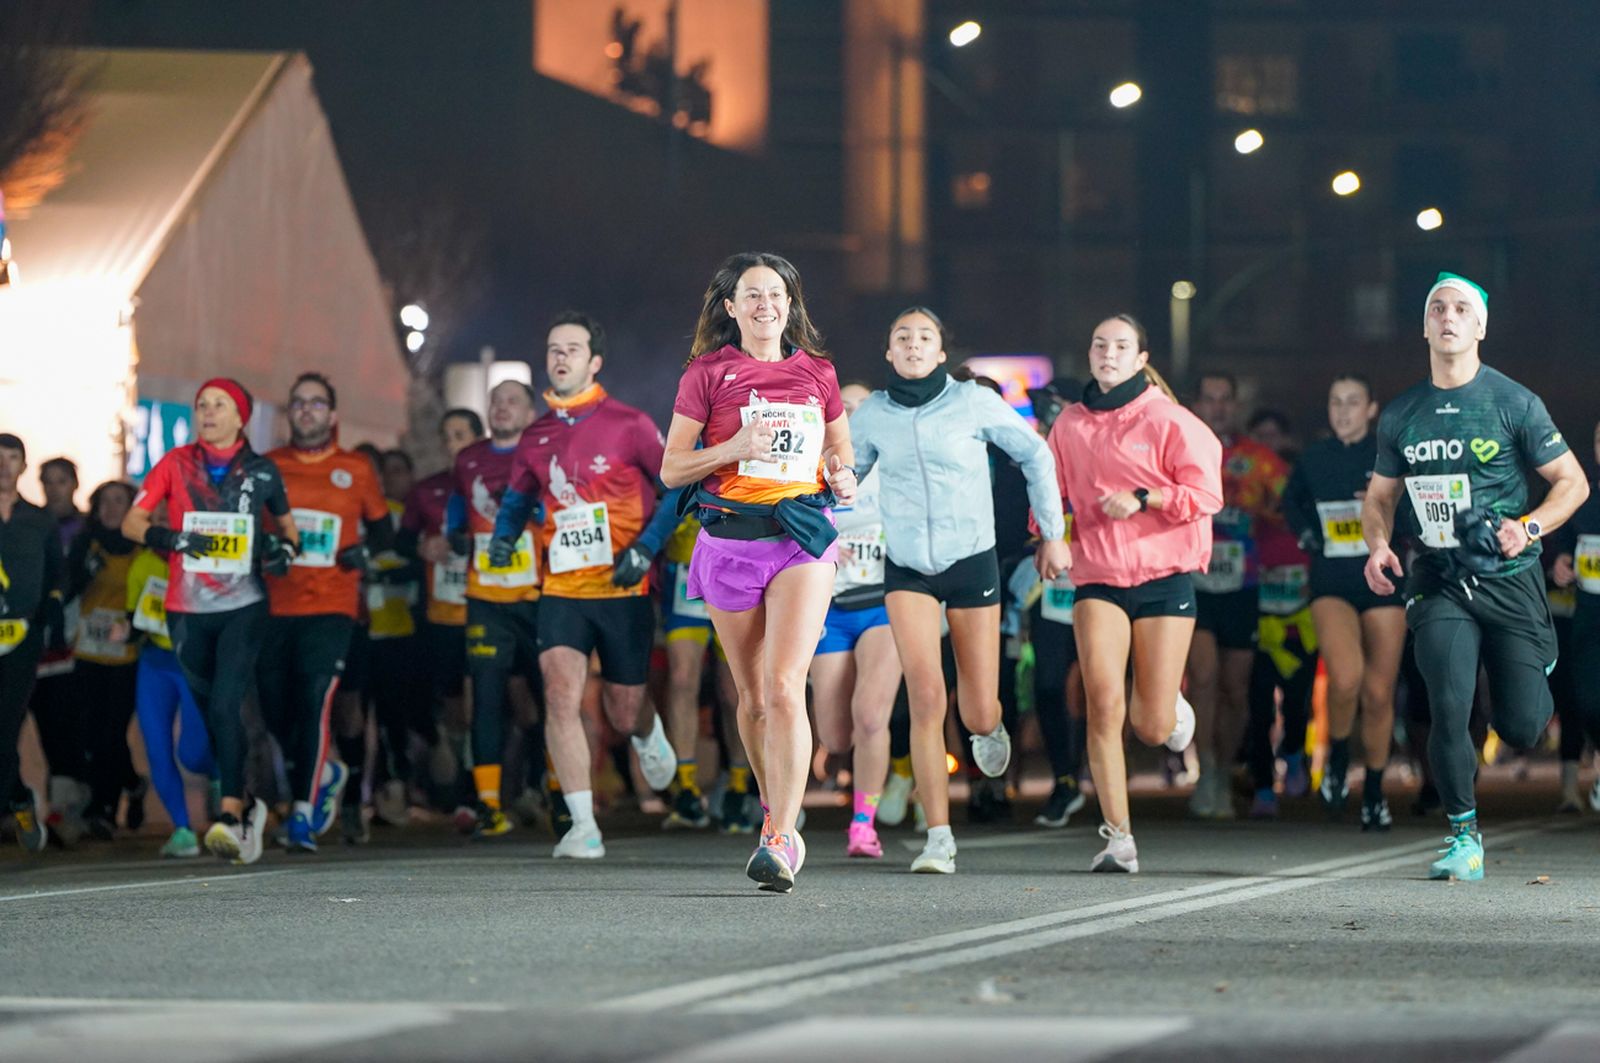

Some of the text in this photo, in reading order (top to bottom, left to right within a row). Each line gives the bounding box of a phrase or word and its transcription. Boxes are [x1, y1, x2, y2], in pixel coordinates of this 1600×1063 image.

[762, 410, 796, 419] NOCHE DE
[1404, 439, 1463, 465] sano
[1425, 501, 1457, 522] 6091
[560, 526, 604, 547] 4354
